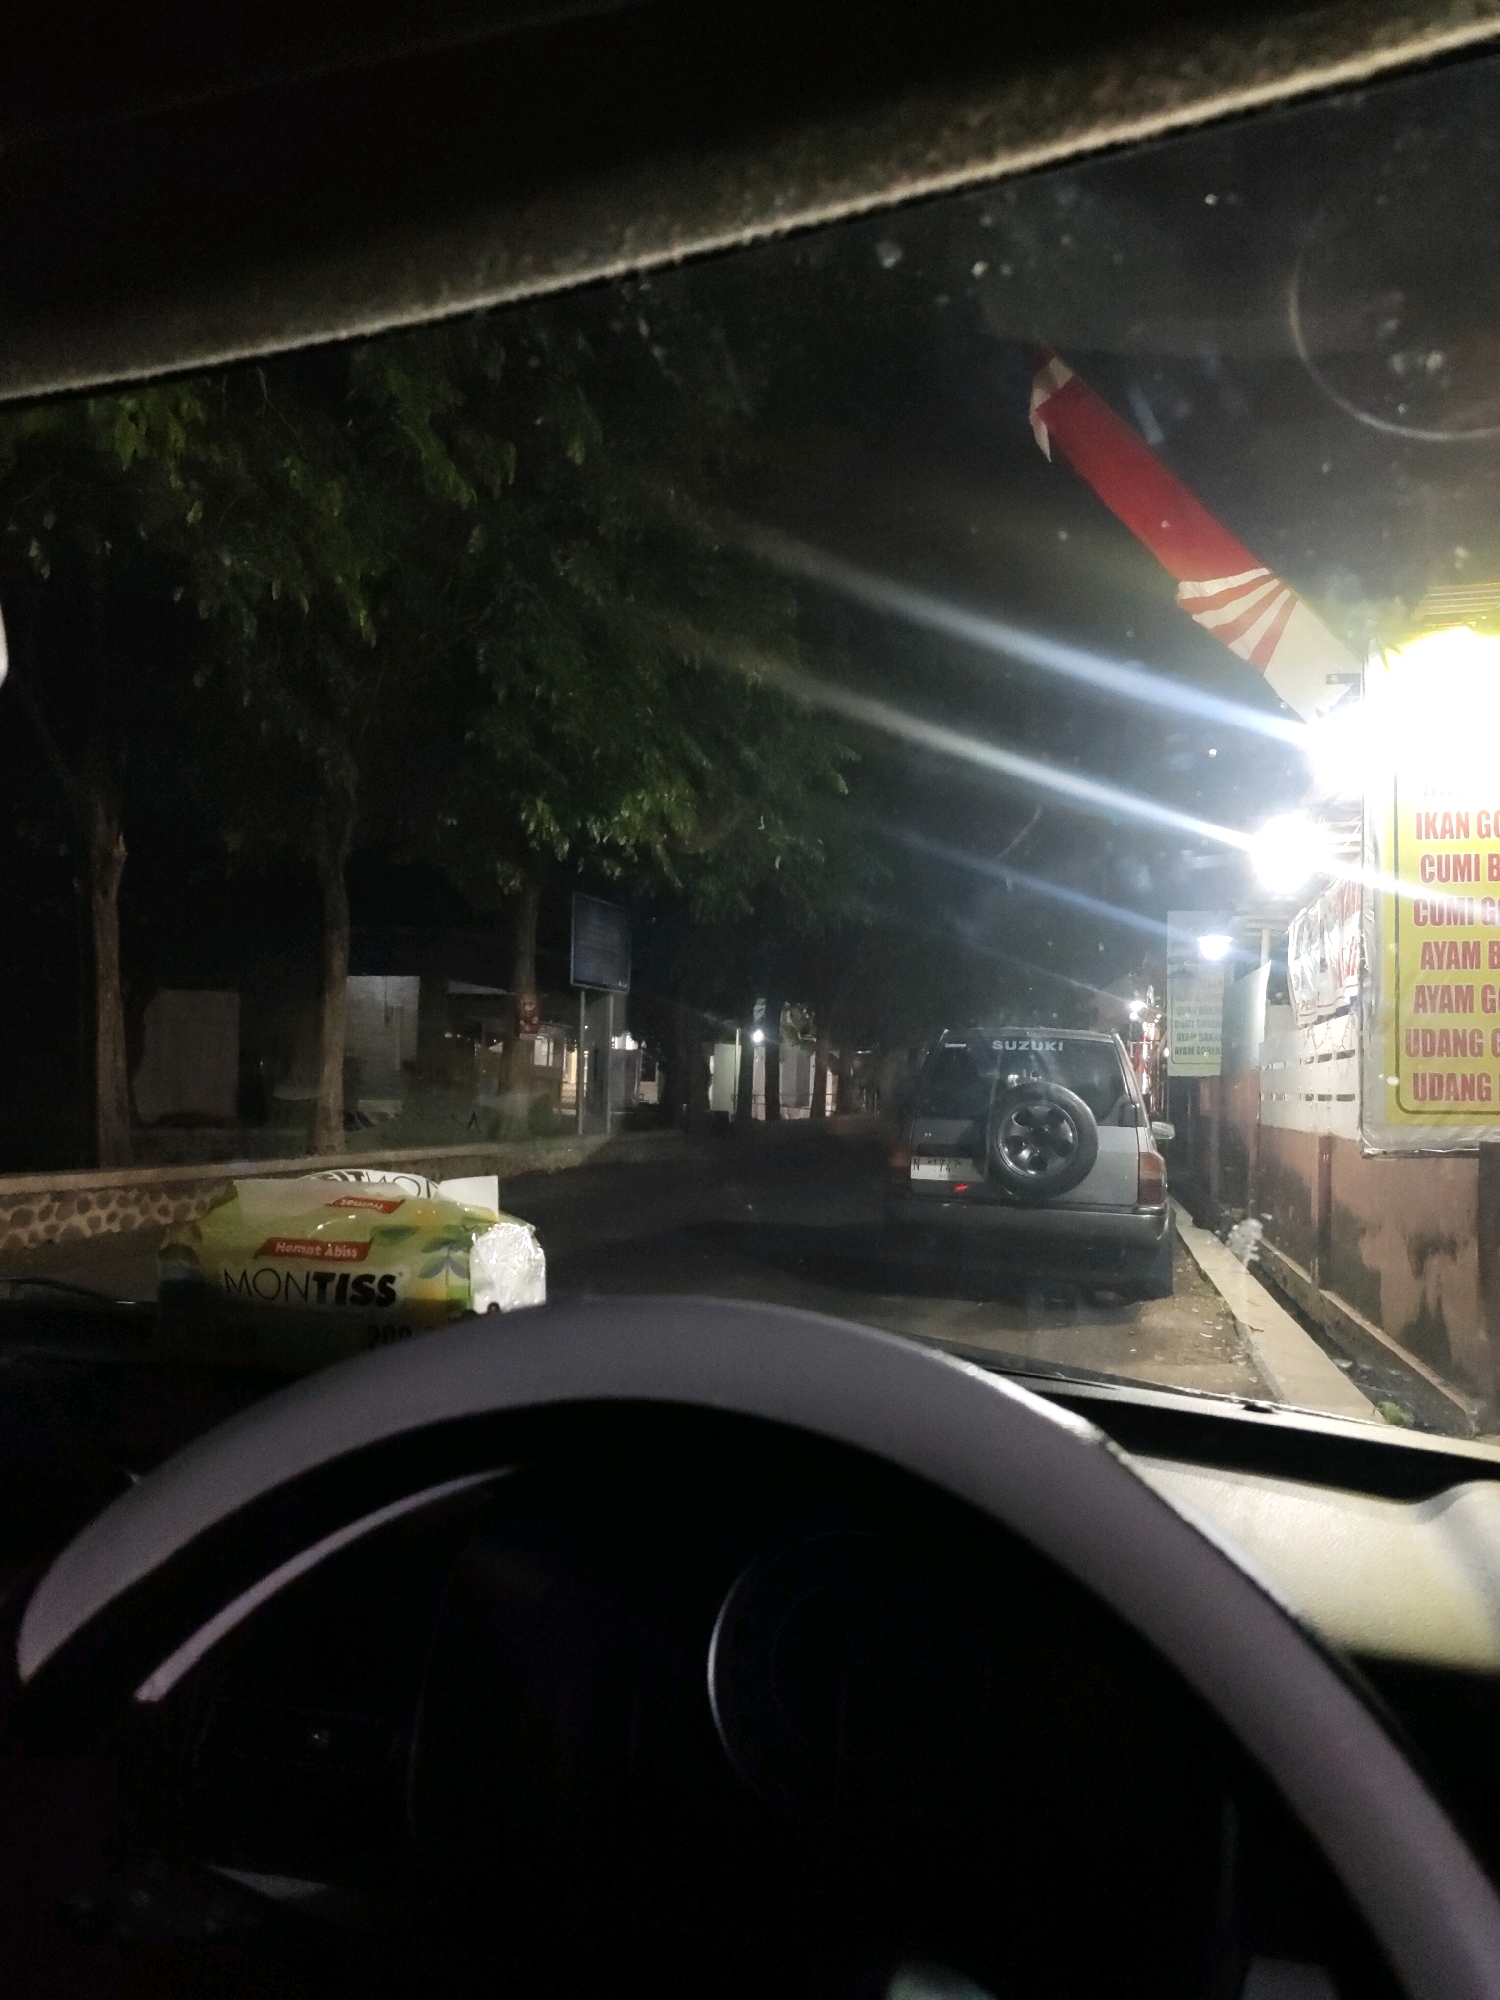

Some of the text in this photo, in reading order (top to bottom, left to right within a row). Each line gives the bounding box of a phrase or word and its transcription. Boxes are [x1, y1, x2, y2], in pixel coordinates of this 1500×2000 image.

[1415, 811, 1470, 840] IKAN
[1420, 853, 1480, 883] CUMI
[1413, 897, 1474, 926] CUMI
[1420, 941, 1481, 970] AYAM
[1413, 984, 1474, 1014] AYAM
[992, 1040, 1064, 1052] SUZUKI
[1405, 1028, 1484, 1058] UDANG
[1412, 1072, 1492, 1102] UDANG
[275, 1242, 358, 1259] Hemat Abiss
[224, 1268, 398, 1308] MONTISS
